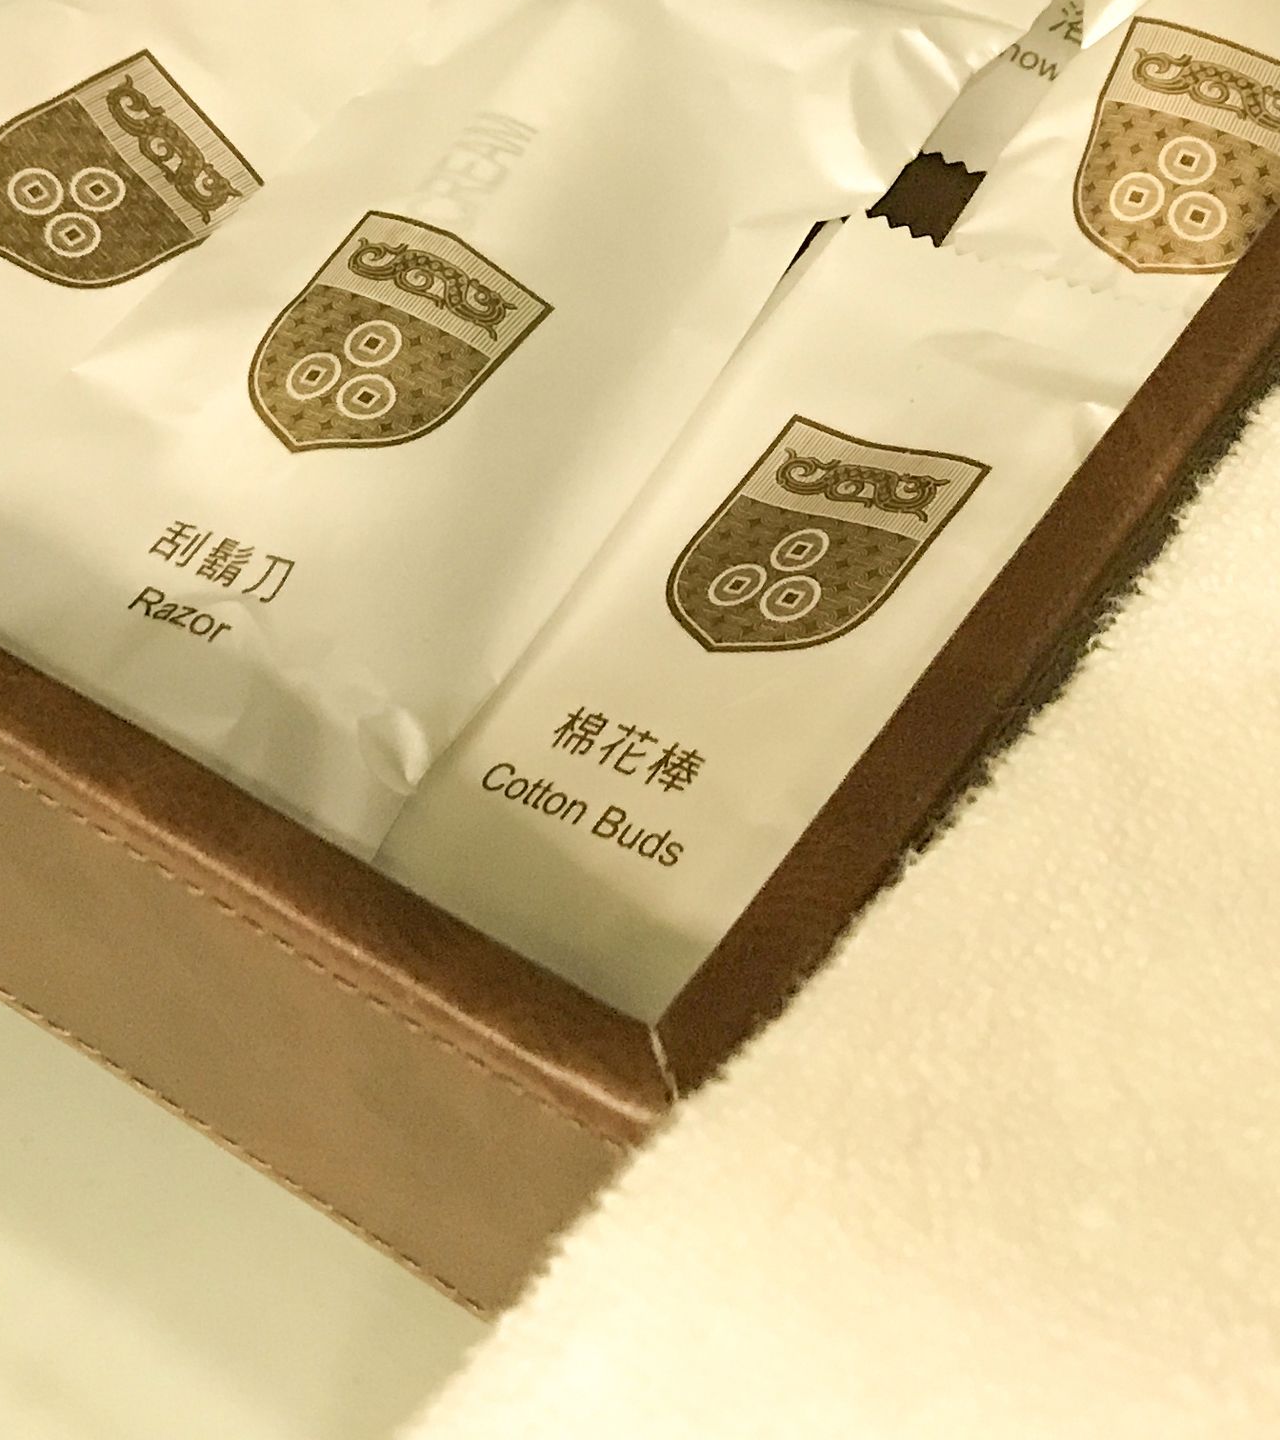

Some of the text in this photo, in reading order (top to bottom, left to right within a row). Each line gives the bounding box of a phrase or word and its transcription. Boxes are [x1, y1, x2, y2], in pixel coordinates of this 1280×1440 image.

[147, 519, 296, 604] 刮鬍刀
[127, 585, 233, 643] Razor
[550, 705, 707, 793] 棉花棒
[481, 762, 685, 868] Cotton Buds
